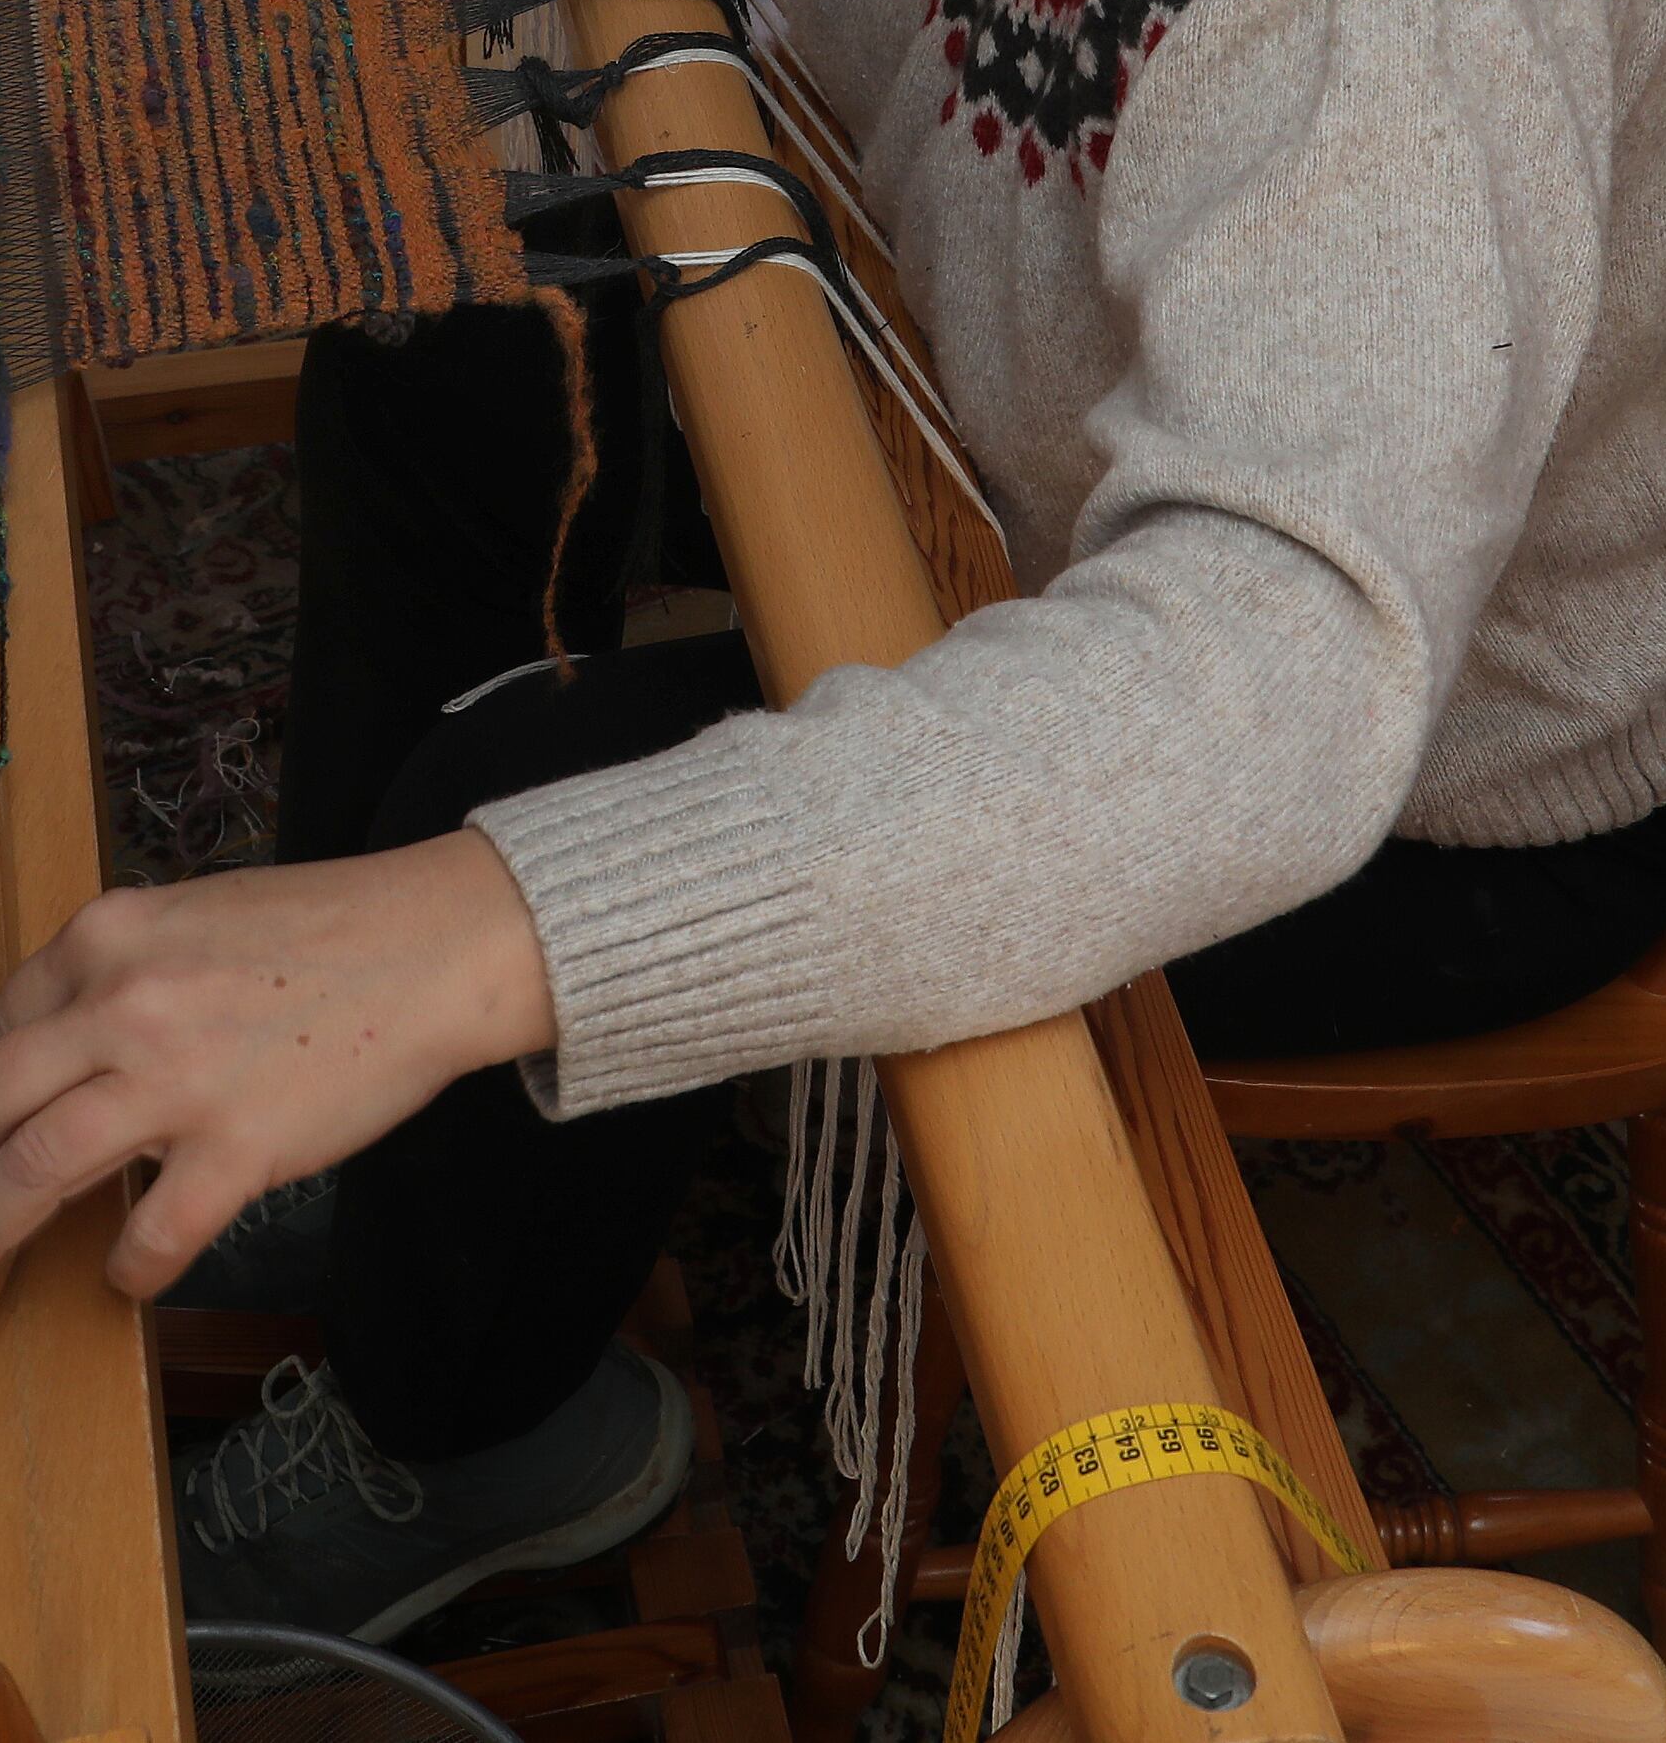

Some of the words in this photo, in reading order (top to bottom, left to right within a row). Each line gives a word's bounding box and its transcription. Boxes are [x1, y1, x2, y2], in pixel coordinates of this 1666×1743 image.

[1120, 1415, 1145, 1431] 32
[1017, 1493, 1031, 1520] 61
[1039, 1466, 1060, 1497] 62
[1074, 1447, 1098, 1475] 63
[1115, 1435, 1141, 1462] 64
[1157, 1428, 1182, 1453] 65
[1197, 1428, 1219, 1451] 66
[1229, 1429, 1250, 1458] 67
